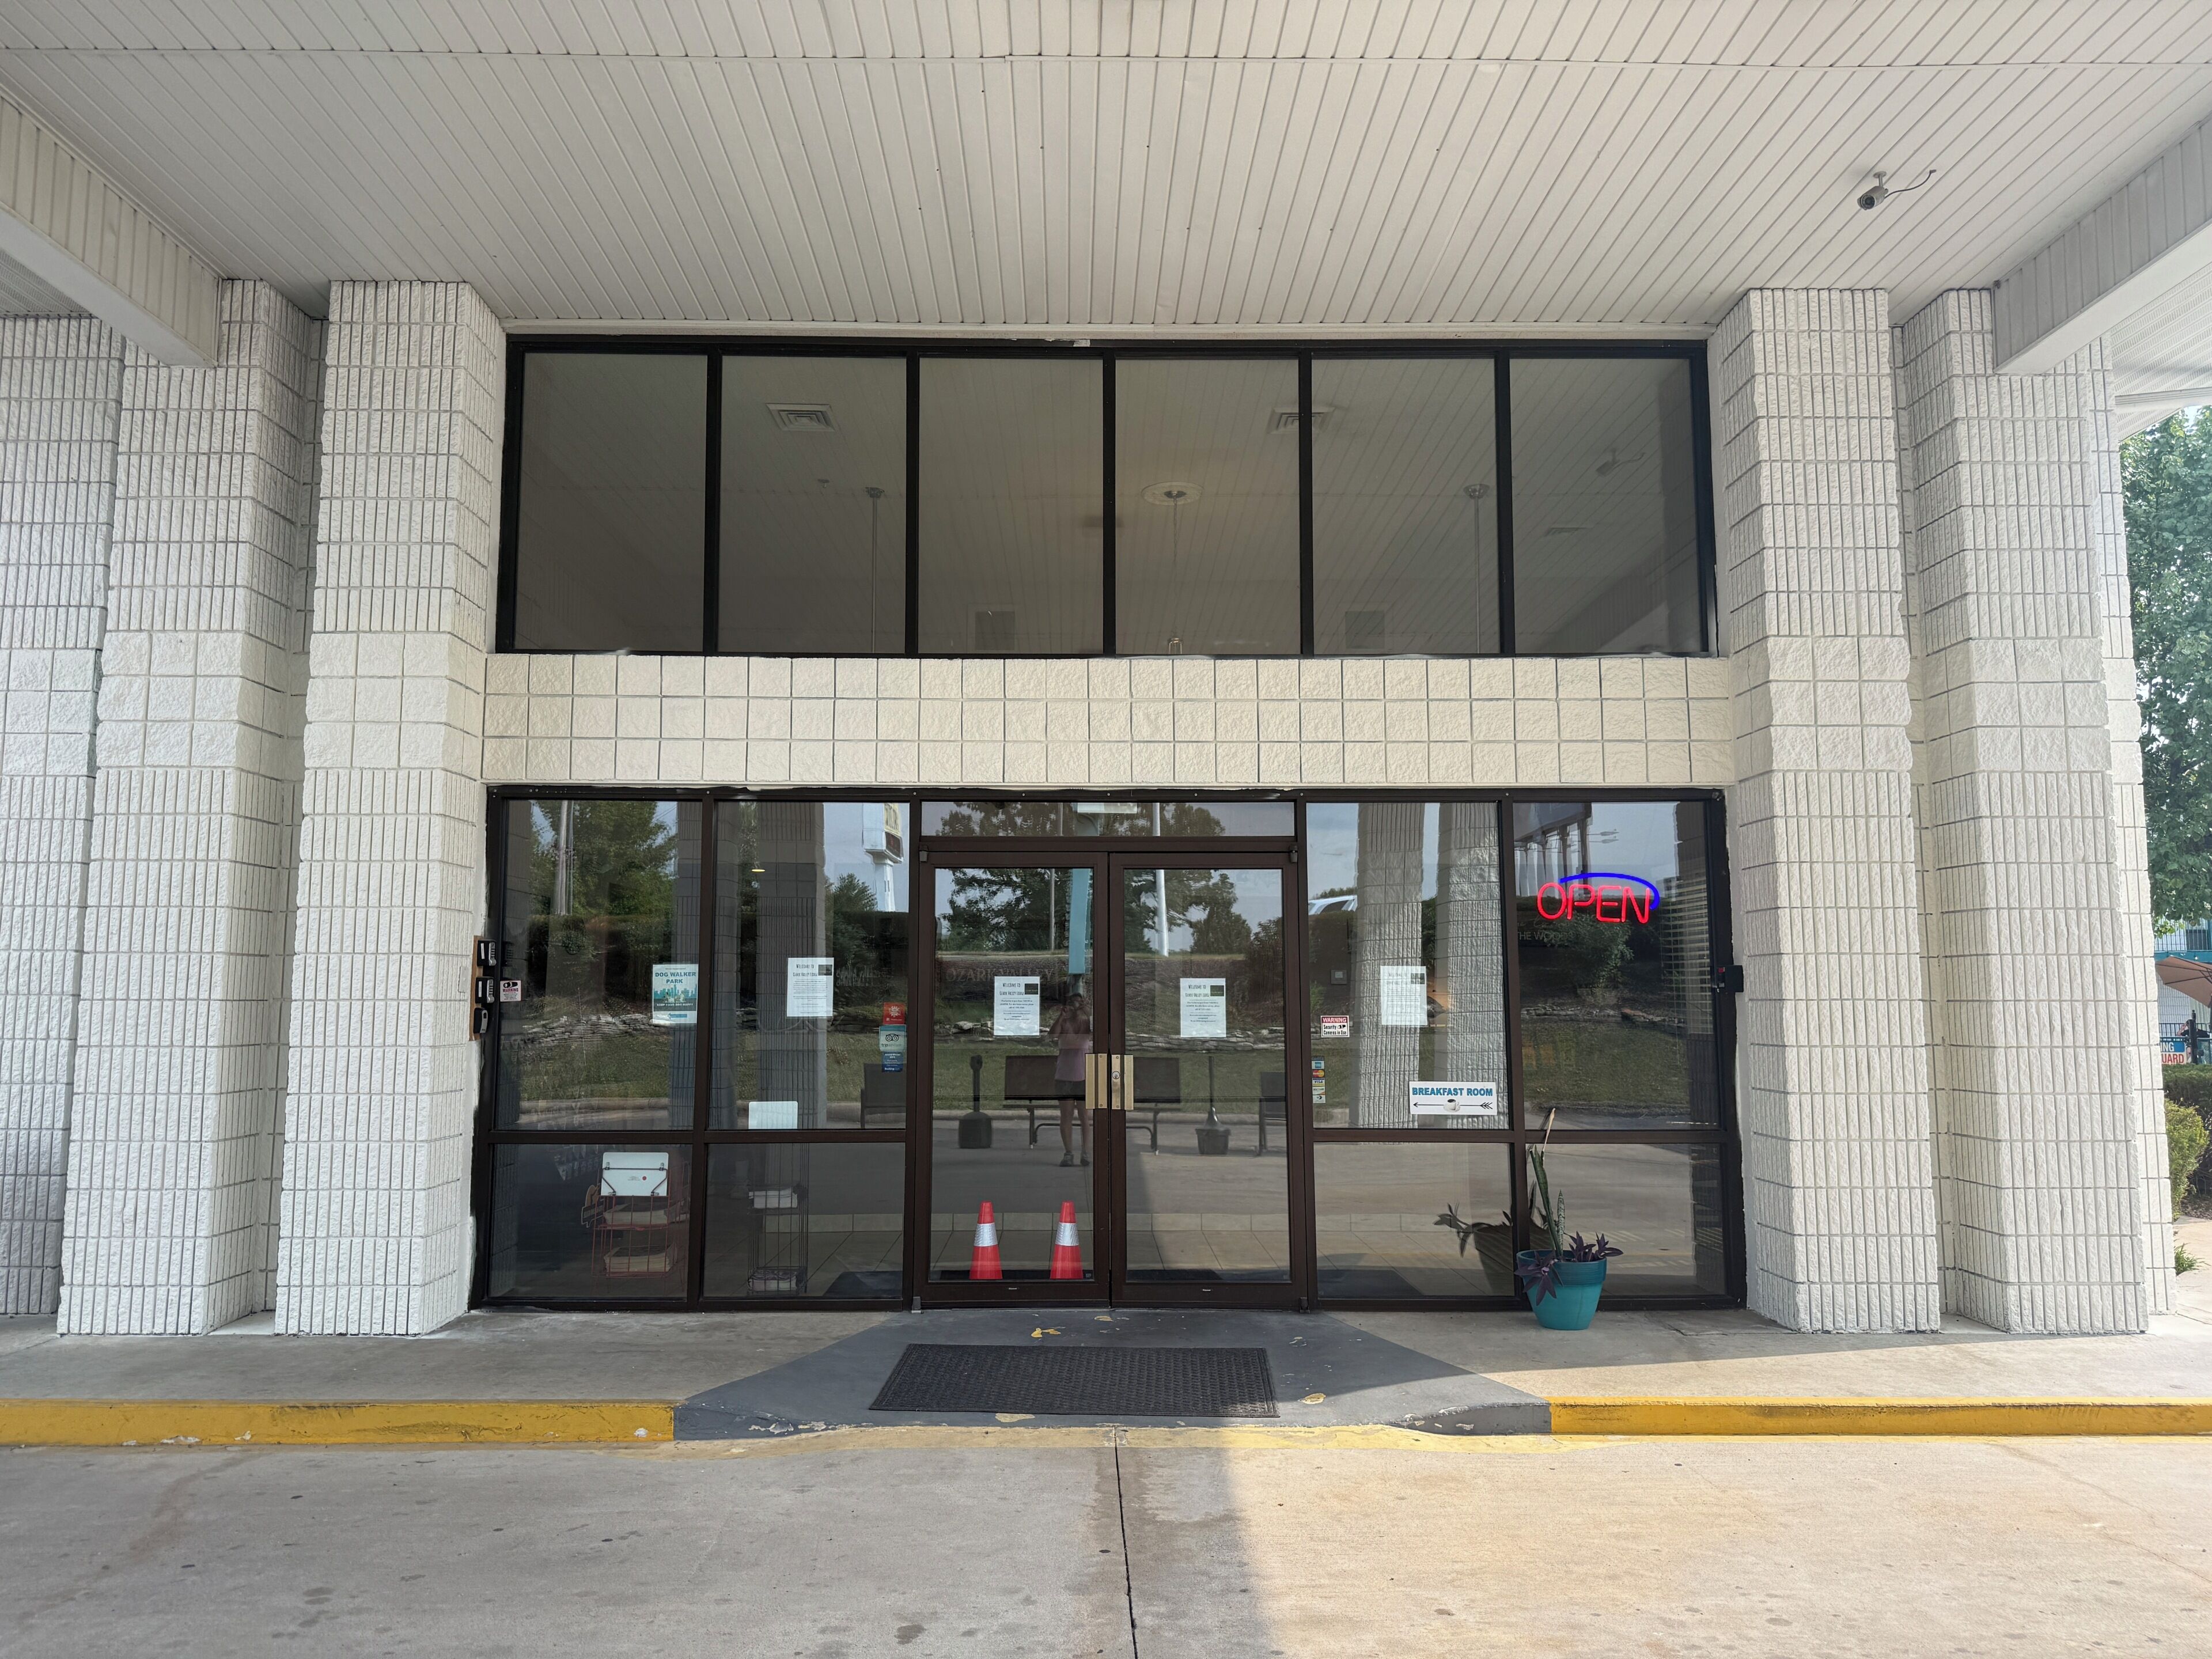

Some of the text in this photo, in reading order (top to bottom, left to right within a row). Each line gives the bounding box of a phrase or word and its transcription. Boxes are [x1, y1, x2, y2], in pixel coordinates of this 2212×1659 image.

[1537, 882, 1650, 923] OPEN
[1412, 1087, 1493, 1096] BREAKFAST ROOM
